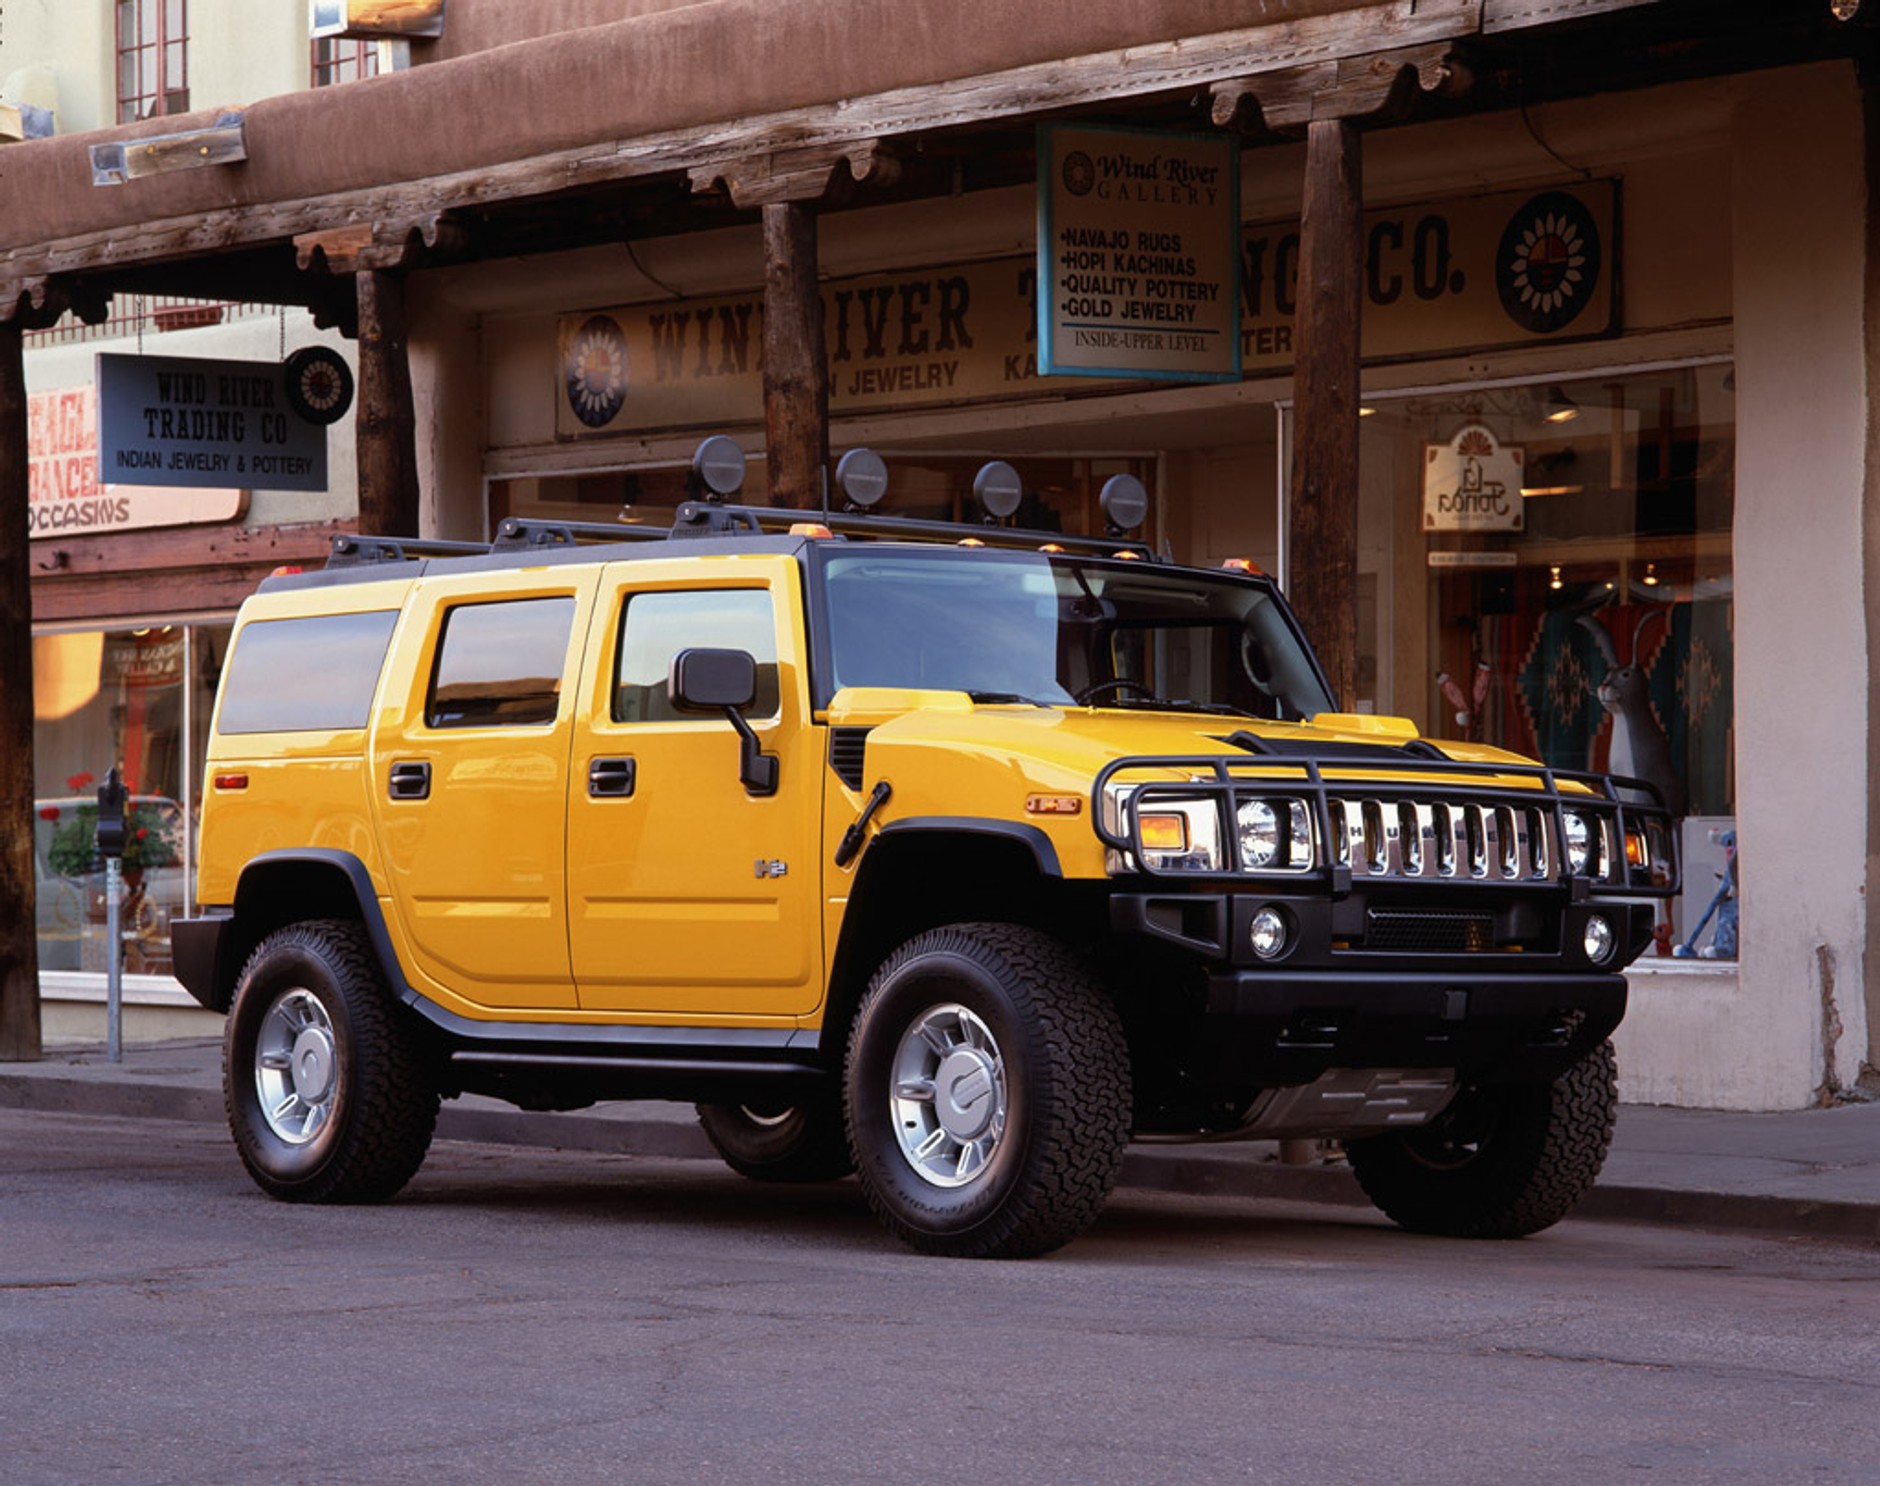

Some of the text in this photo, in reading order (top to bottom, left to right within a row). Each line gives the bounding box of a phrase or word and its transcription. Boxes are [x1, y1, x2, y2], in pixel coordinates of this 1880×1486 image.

[1098, 154, 1219, 187] Wind River
[1097, 181, 1217, 206] GALLERY
[1065, 228, 1181, 251] NAVAJO RUGS
[1066, 252, 1196, 276] HOPI KACHINAS
[1366, 215, 1465, 305] CO.
[1066, 274, 1219, 301] QUALITY POTTERY
[1067, 300, 1196, 323] GOLD JEWELRY
[649, 303, 764, 381] WIN
[822, 275, 973, 361] IVER
[1075, 331, 1207, 353] INSIDE-UPPER LEVEL
[157, 373, 275, 408] WIND RIVER
[849, 361, 958, 395] JEWELRY
[144, 408, 287, 445] TRADING CO
[117, 451, 313, 476] INDIAN JEWELRY & POTTERY
